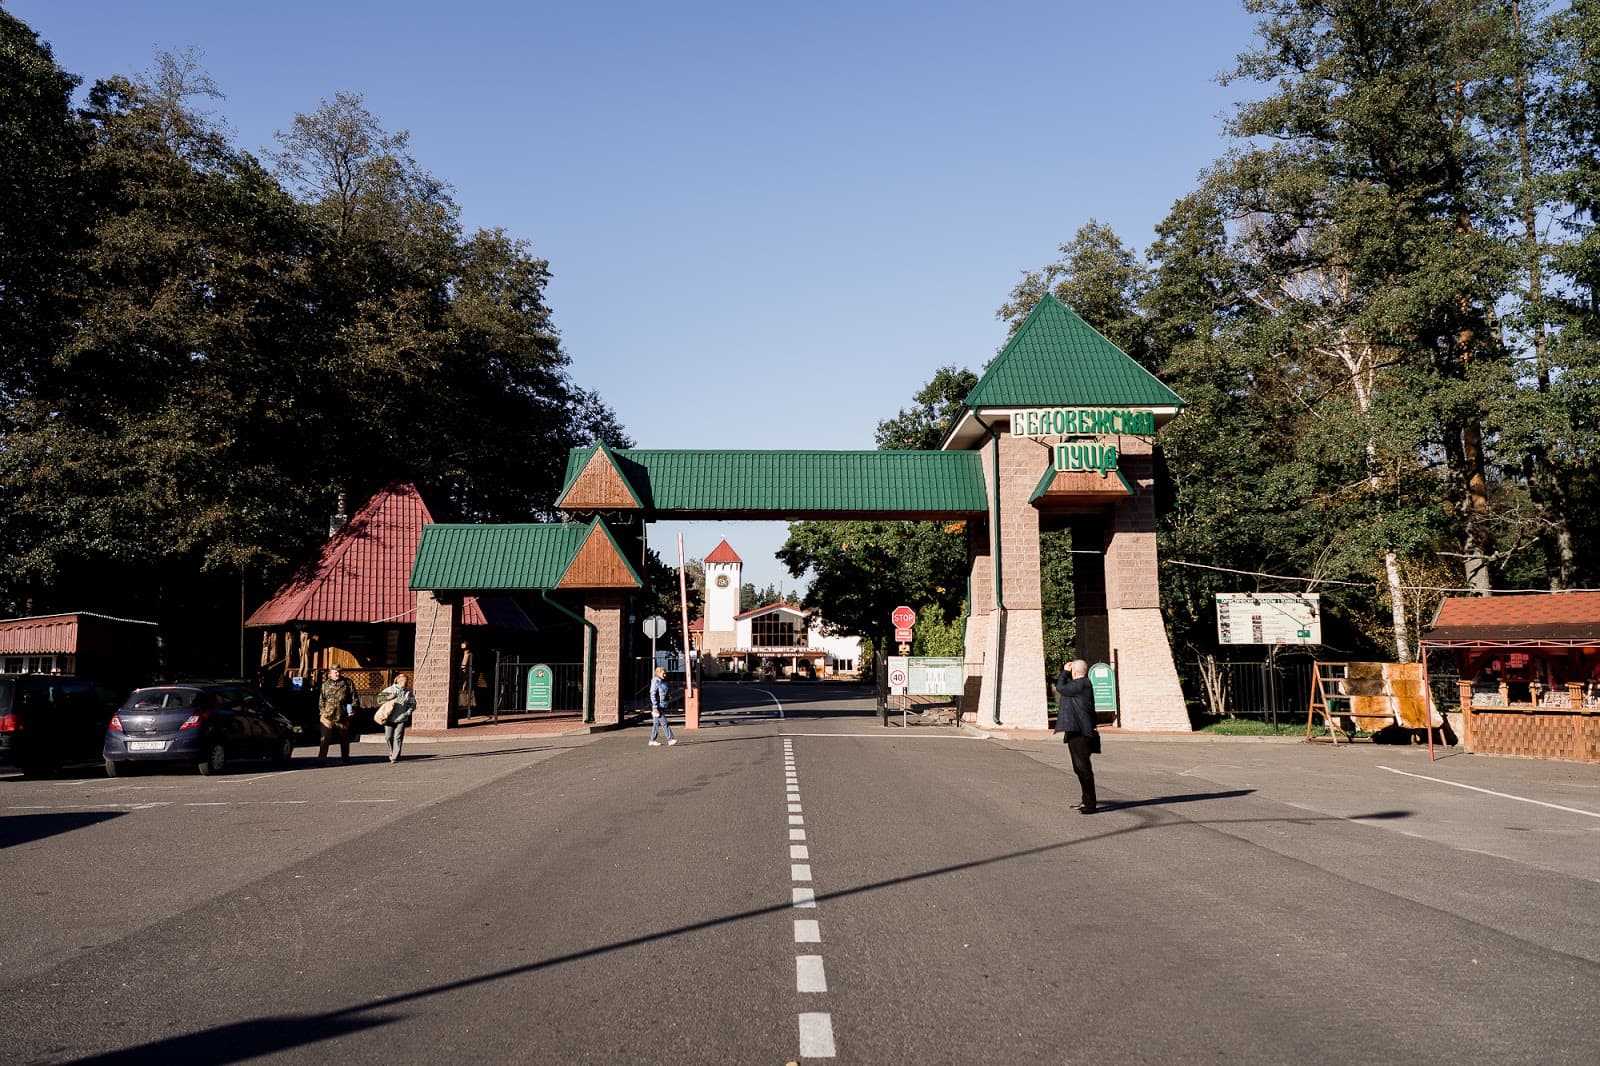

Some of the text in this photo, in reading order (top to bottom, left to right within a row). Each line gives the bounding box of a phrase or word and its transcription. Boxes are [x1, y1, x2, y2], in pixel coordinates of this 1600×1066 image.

[1012, 409, 1155, 436] БЕЛОВЕЖСКАЯ
[1056, 444, 1117, 476] ПУЩА
[894, 614, 913, 622] STOP
[893, 674, 902, 682] 40
